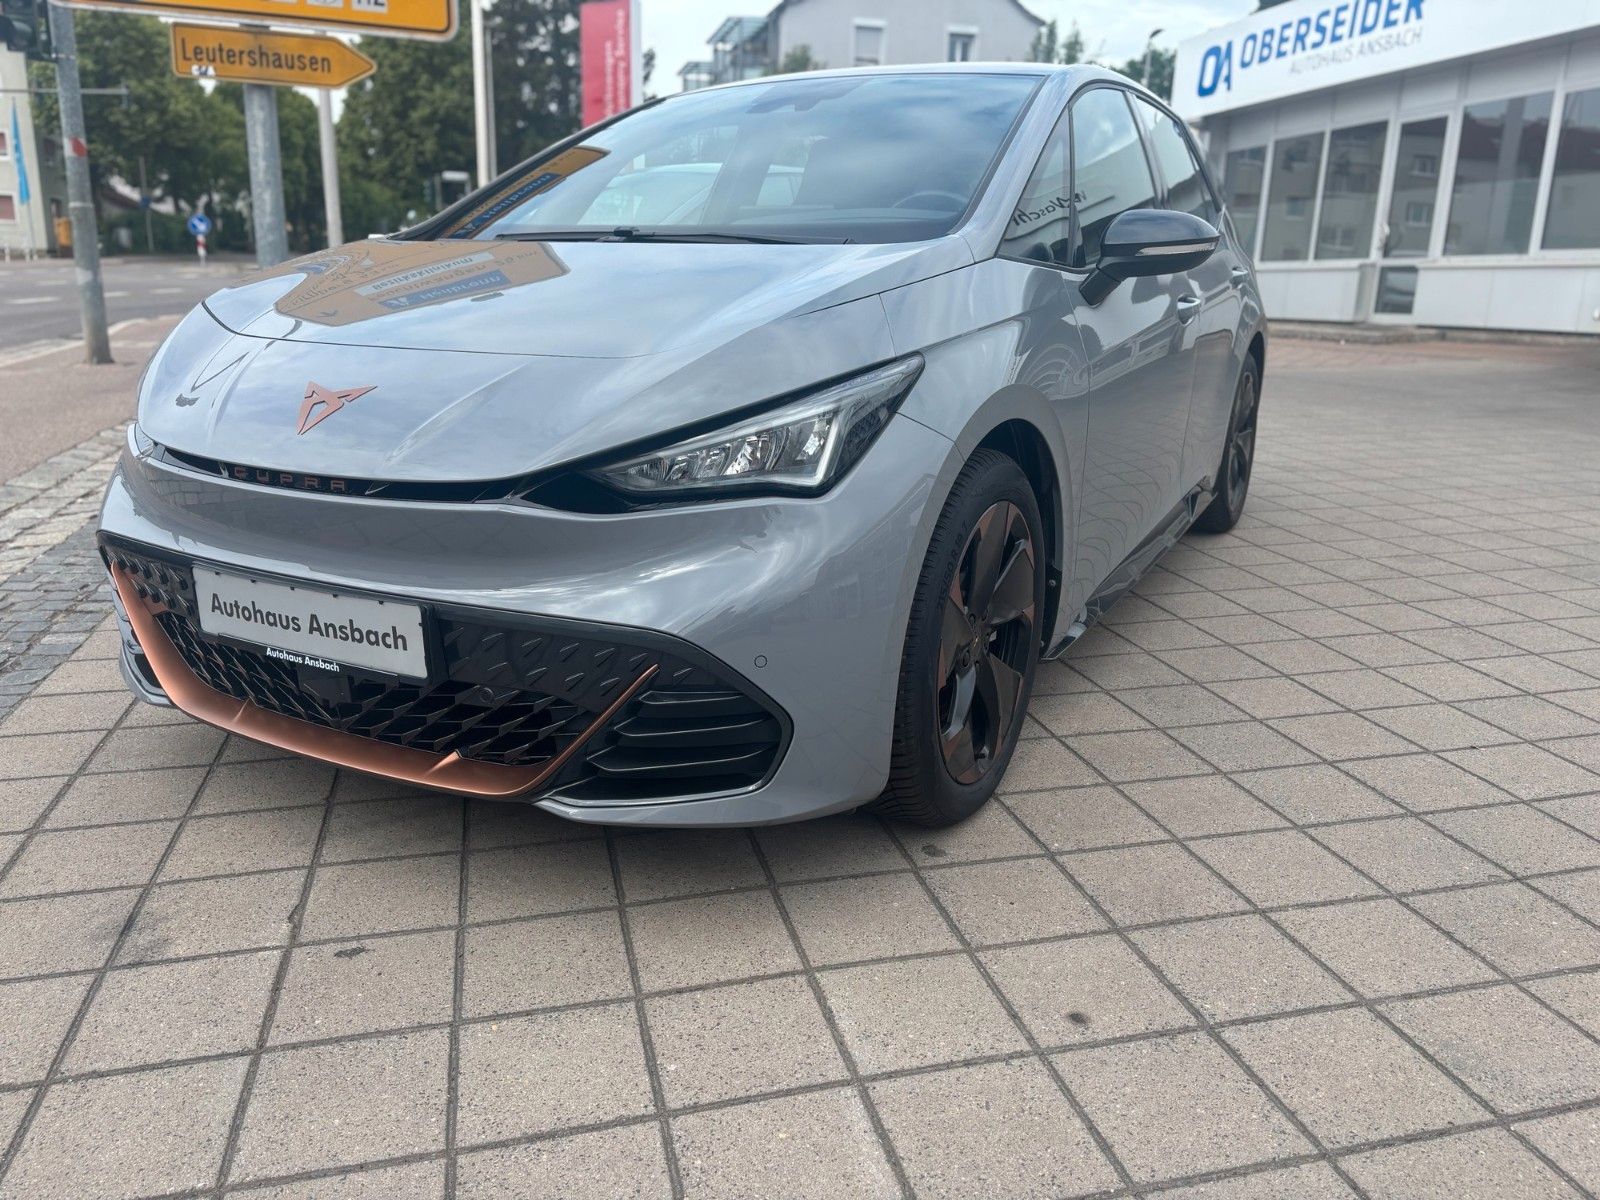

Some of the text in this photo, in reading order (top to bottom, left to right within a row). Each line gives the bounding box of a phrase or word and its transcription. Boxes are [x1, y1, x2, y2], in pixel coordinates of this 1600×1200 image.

[1240, 0, 1424, 69] OBERSEIDER
[1354, 27, 1424, 57] ANSBACH
[181, 37, 331, 73] Leutershausen
[234, 466, 346, 492] CUPRA
[211, 592, 408, 651] Autohaus Ansbach
[266, 647, 340, 672] Autohaus Ansbach
